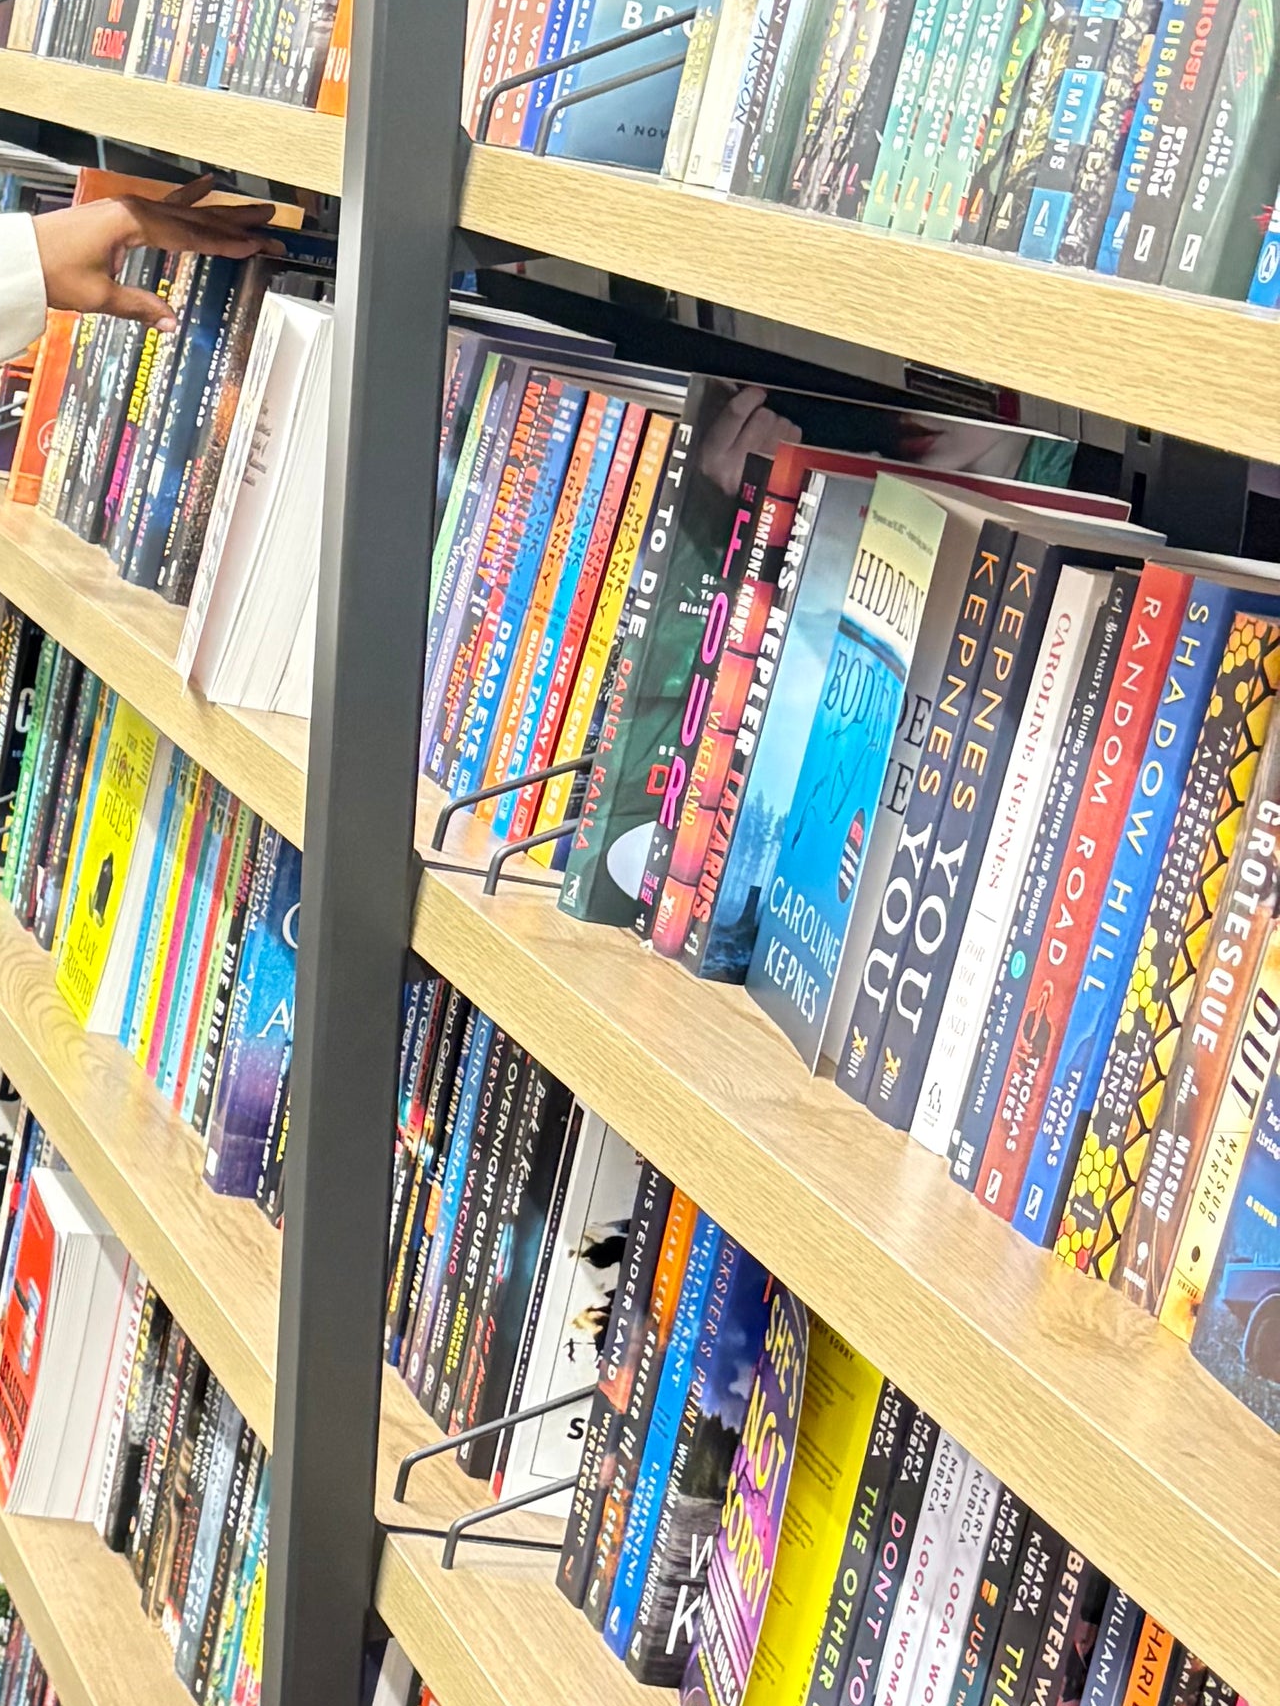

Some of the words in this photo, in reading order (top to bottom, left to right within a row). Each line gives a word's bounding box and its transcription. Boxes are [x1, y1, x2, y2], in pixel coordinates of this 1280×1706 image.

[662, 423, 693, 490] FIT
[649, 503, 675, 554] TO
[777, 491, 818, 592] LARS
[627, 569, 659, 640] DIE
[849, 548, 926, 643] HIDDEN
[596, 656, 633, 754] DANIEL
[734, 605, 788, 757] KEPLER
[917, 550, 1001, 799] KEPNES
[573, 767, 607, 851] KALLA
[691, 767, 745, 924] LAZARUS
[769, 876, 841, 980] CAROLINE
[862, 822, 930, 1015] YOU
[1191, 799, 1280, 1054] GROTESQUE
[764, 935, 820, 1026] KEPNES
[485, 1060, 520, 1205] OVERNIGHT
[465, 1210, 490, 1292] GUEST
[763, 1293, 801, 1419] SHE'S
[739, 1389, 788, 1515] NOT
[721, 1475, 770, 1618] SORRY
[852, 1481, 879, 1555] THE
[865, 1512, 907, 1640] DON'T
[816, 1569, 857, 1692] OTHER
[1042, 1550, 1083, 1670] BETTER
